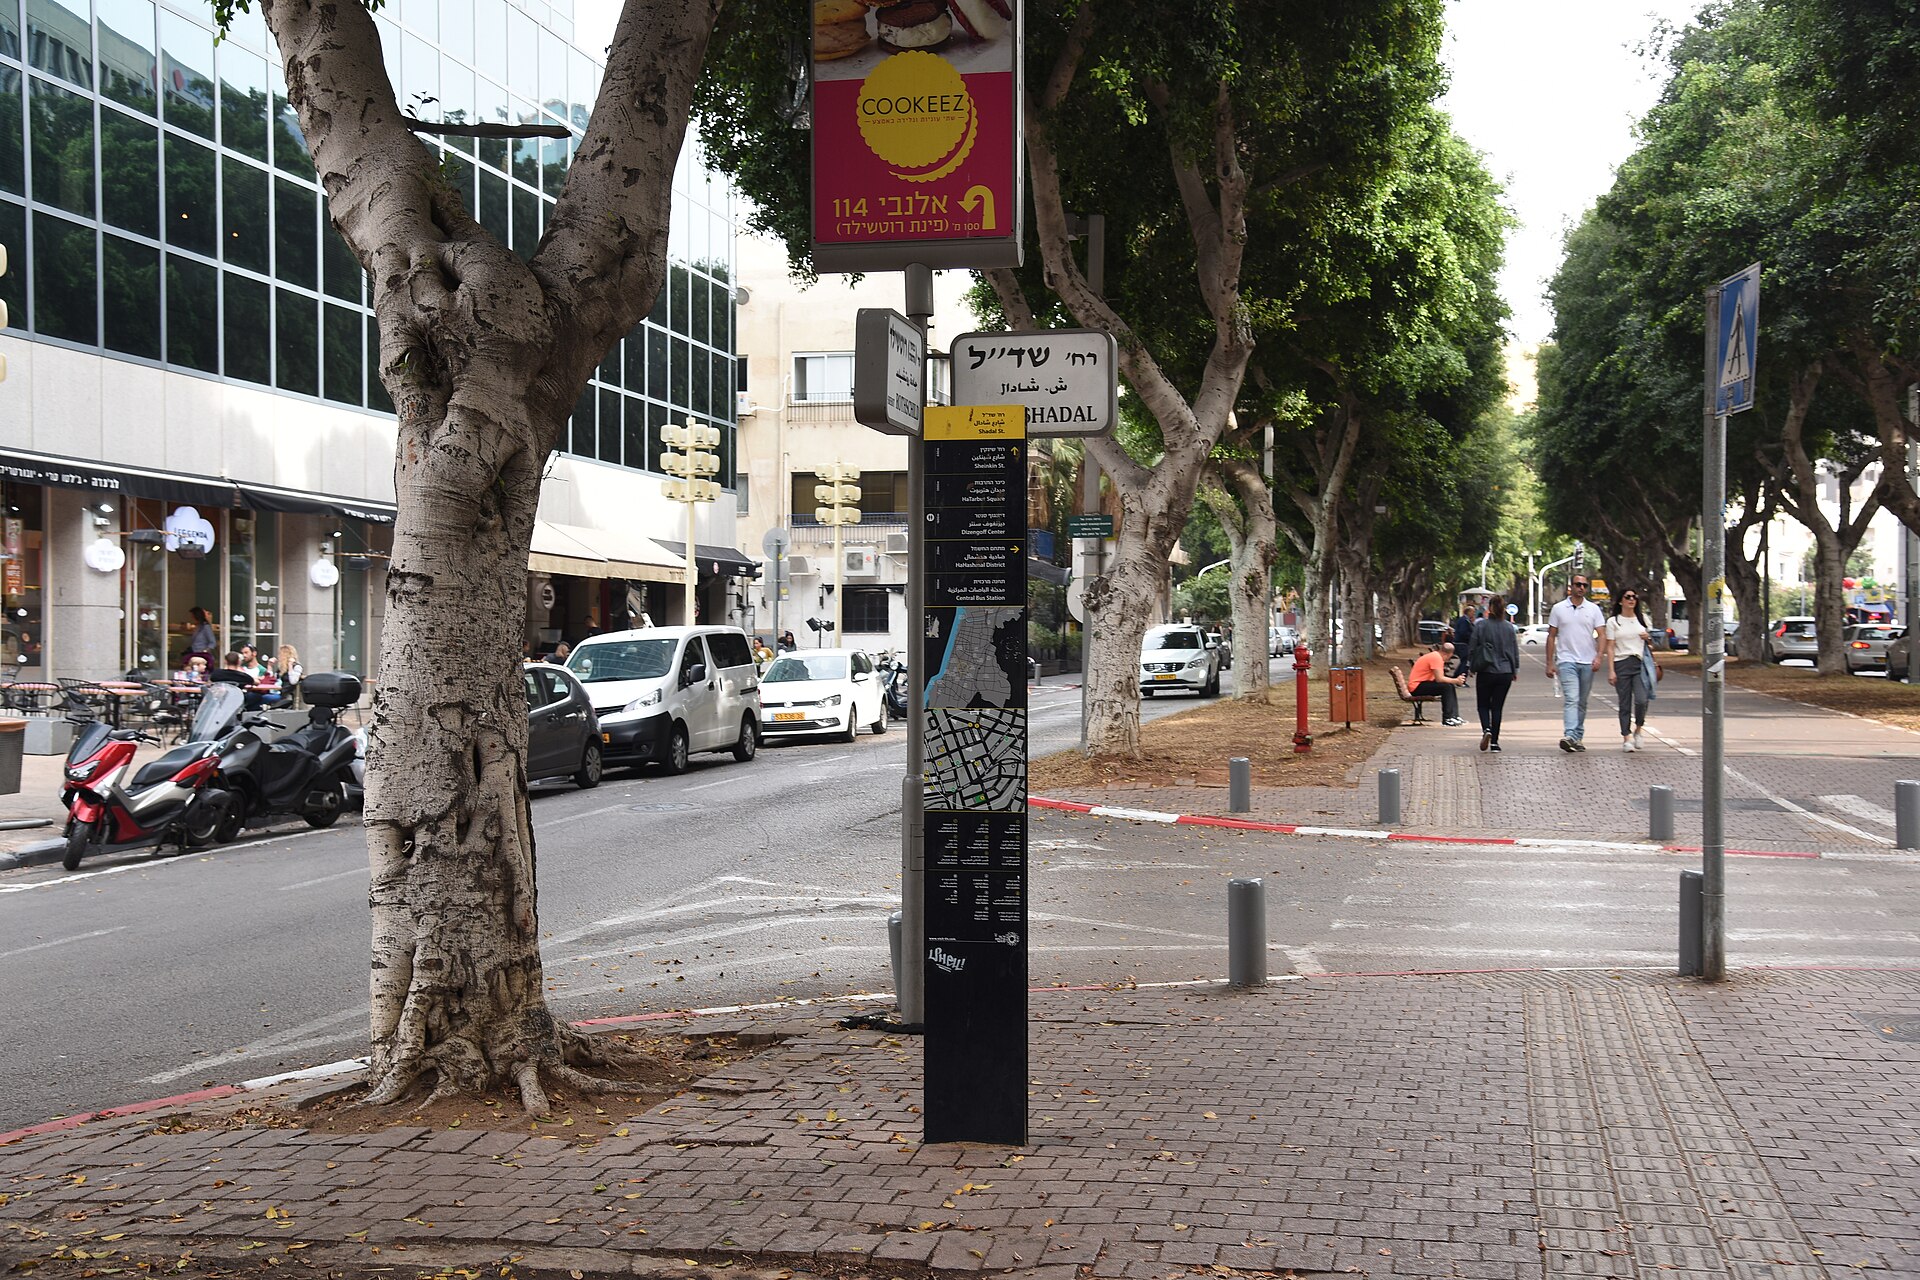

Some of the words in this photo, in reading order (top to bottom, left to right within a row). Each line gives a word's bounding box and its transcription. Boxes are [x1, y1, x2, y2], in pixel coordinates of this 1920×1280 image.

[862, 94, 965, 116] COOKEEZ
[833, 198, 869, 218] 114
[879, 191, 948, 216] אלנבי
[836, 220, 904, 236] רוטשילד)
[909, 218, 949, 233] (פינת
[963, 223, 980, 231] 100
[1064, 351, 1098, 367] רח'
[991, 419, 1005, 427] شارع
[991, 454, 1005, 462] شارع
